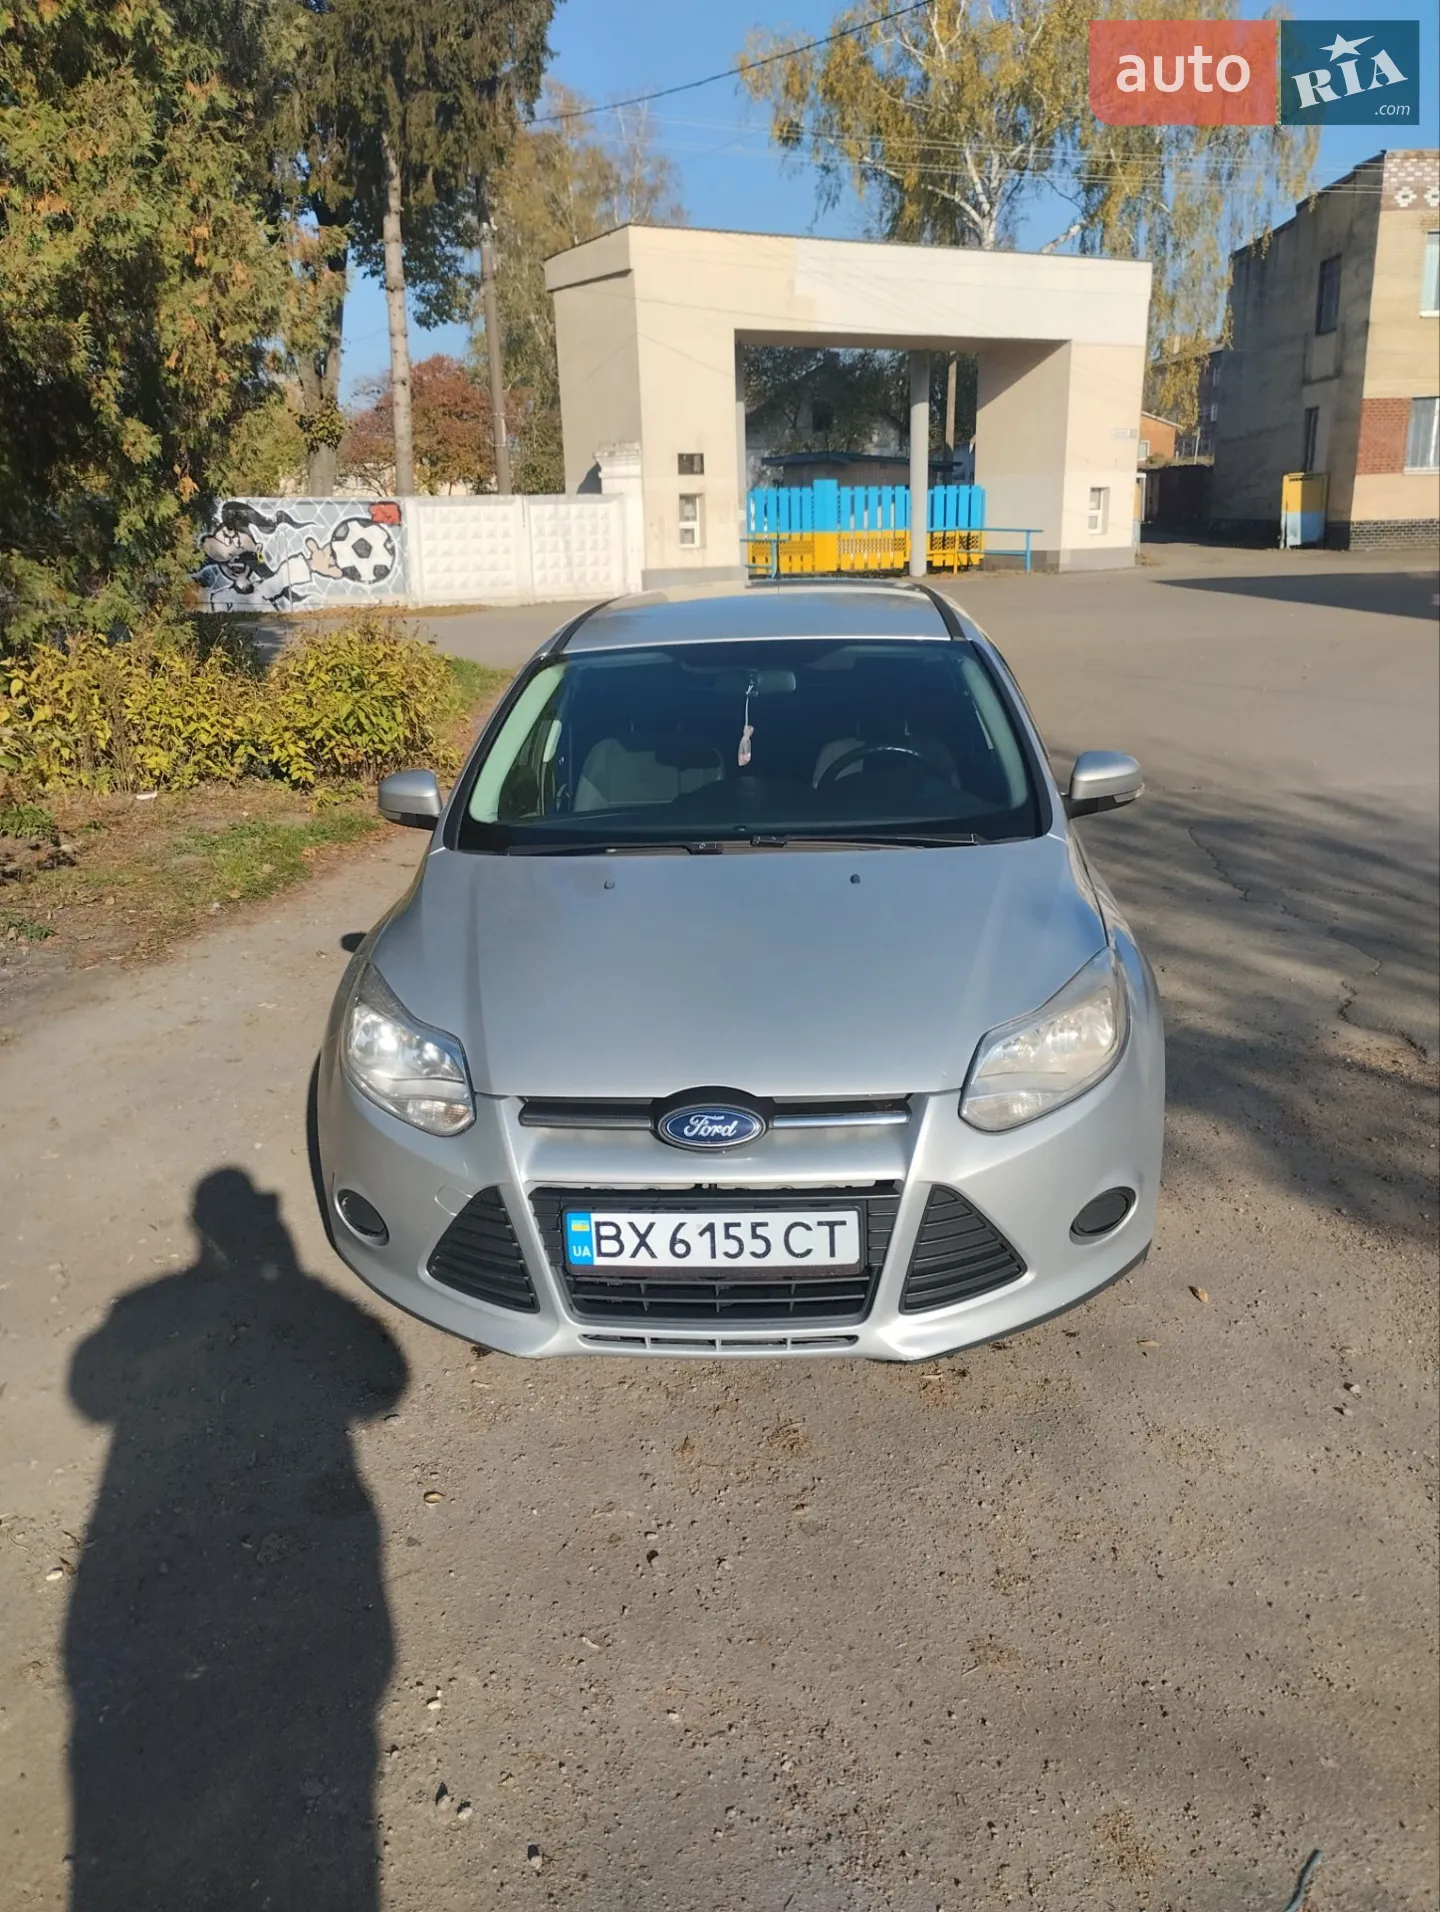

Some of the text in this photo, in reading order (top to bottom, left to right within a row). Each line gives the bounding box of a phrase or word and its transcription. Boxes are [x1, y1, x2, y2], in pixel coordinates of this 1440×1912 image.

[683, 1114, 739, 1137] Ford
[594, 1220, 847, 1259] BX 6155 CT
[572, 1245, 592, 1258] UA
